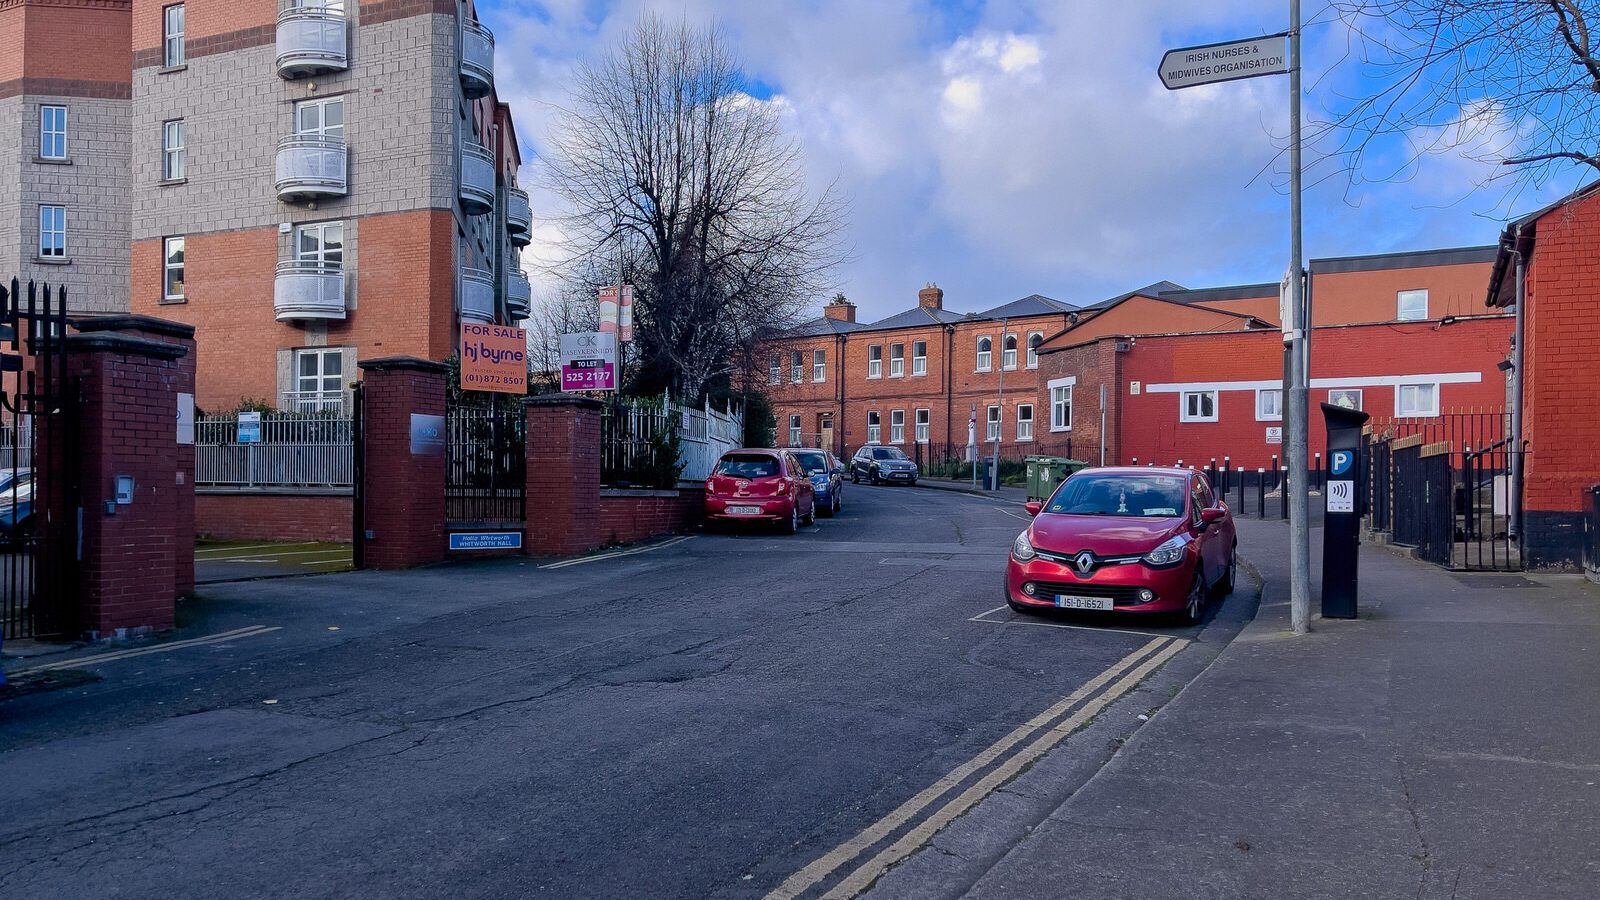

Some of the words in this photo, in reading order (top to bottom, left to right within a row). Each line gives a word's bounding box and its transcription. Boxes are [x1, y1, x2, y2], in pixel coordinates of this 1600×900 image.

[1185, 52, 1209, 63] IRISH
[1211, 46, 1250, 59] NURSES
[1252, 45, 1259, 53] &
[1168, 66, 1211, 80] MIDWIVES
[1213, 56, 1283, 74] ORGANISATION
[464, 325, 490, 336] FOR
[493, 327, 524, 339] SALE
[480, 342, 524, 364] byrne
[503, 376, 524, 385] 8507
[566, 372, 584, 382] 525
[586, 371, 610, 381] 2177
[1334, 453, 1347, 471] P
[1064, 598, 1104, 609] 151-D-16521
